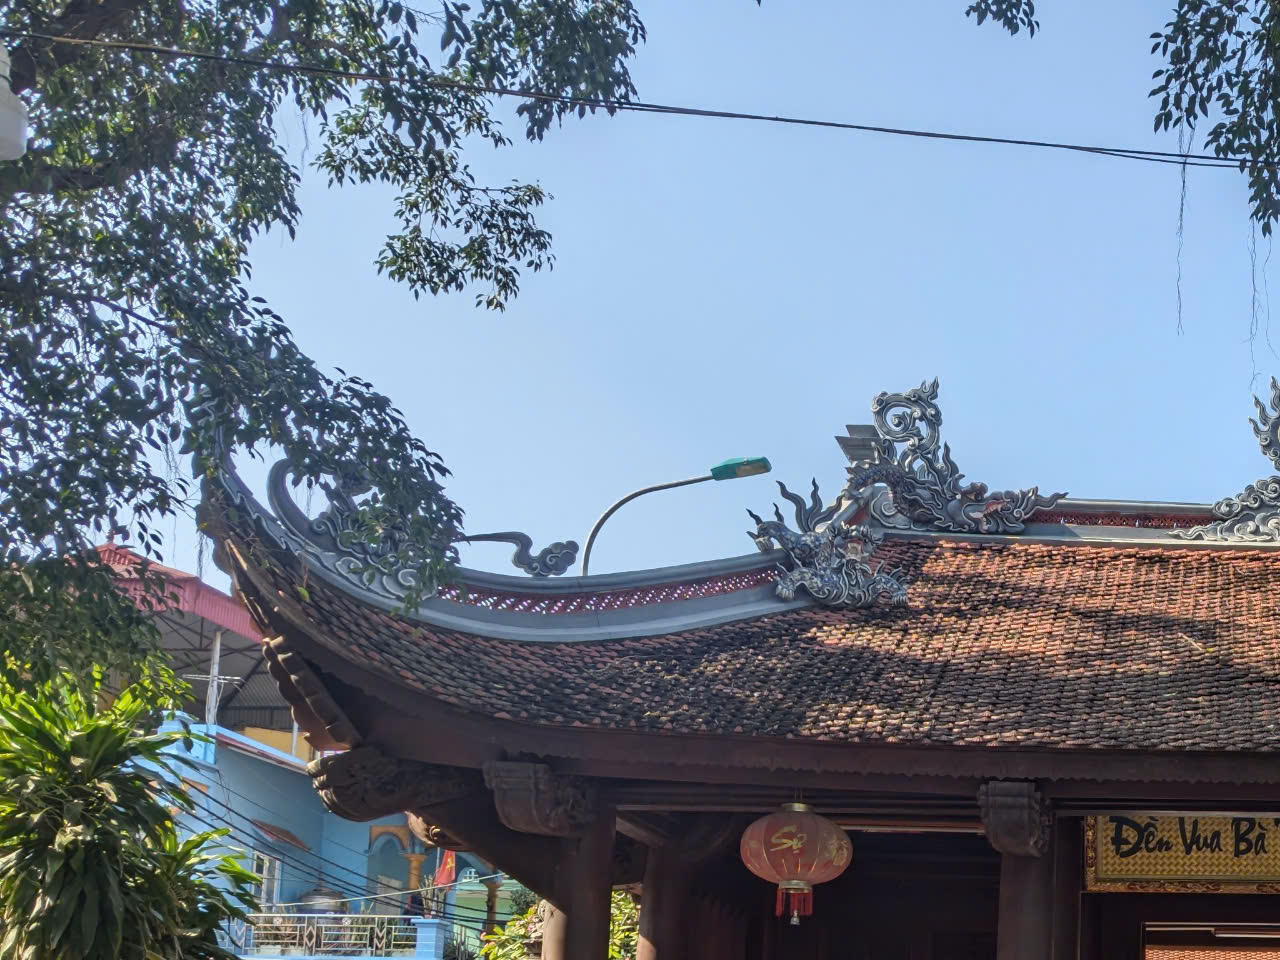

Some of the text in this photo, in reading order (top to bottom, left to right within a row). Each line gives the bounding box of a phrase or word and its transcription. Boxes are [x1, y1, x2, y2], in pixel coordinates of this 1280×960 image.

[1109, 815, 1174, 859] Đền
[1178, 816, 1223, 856] Vua
[1231, 817, 1268, 858] Bà
